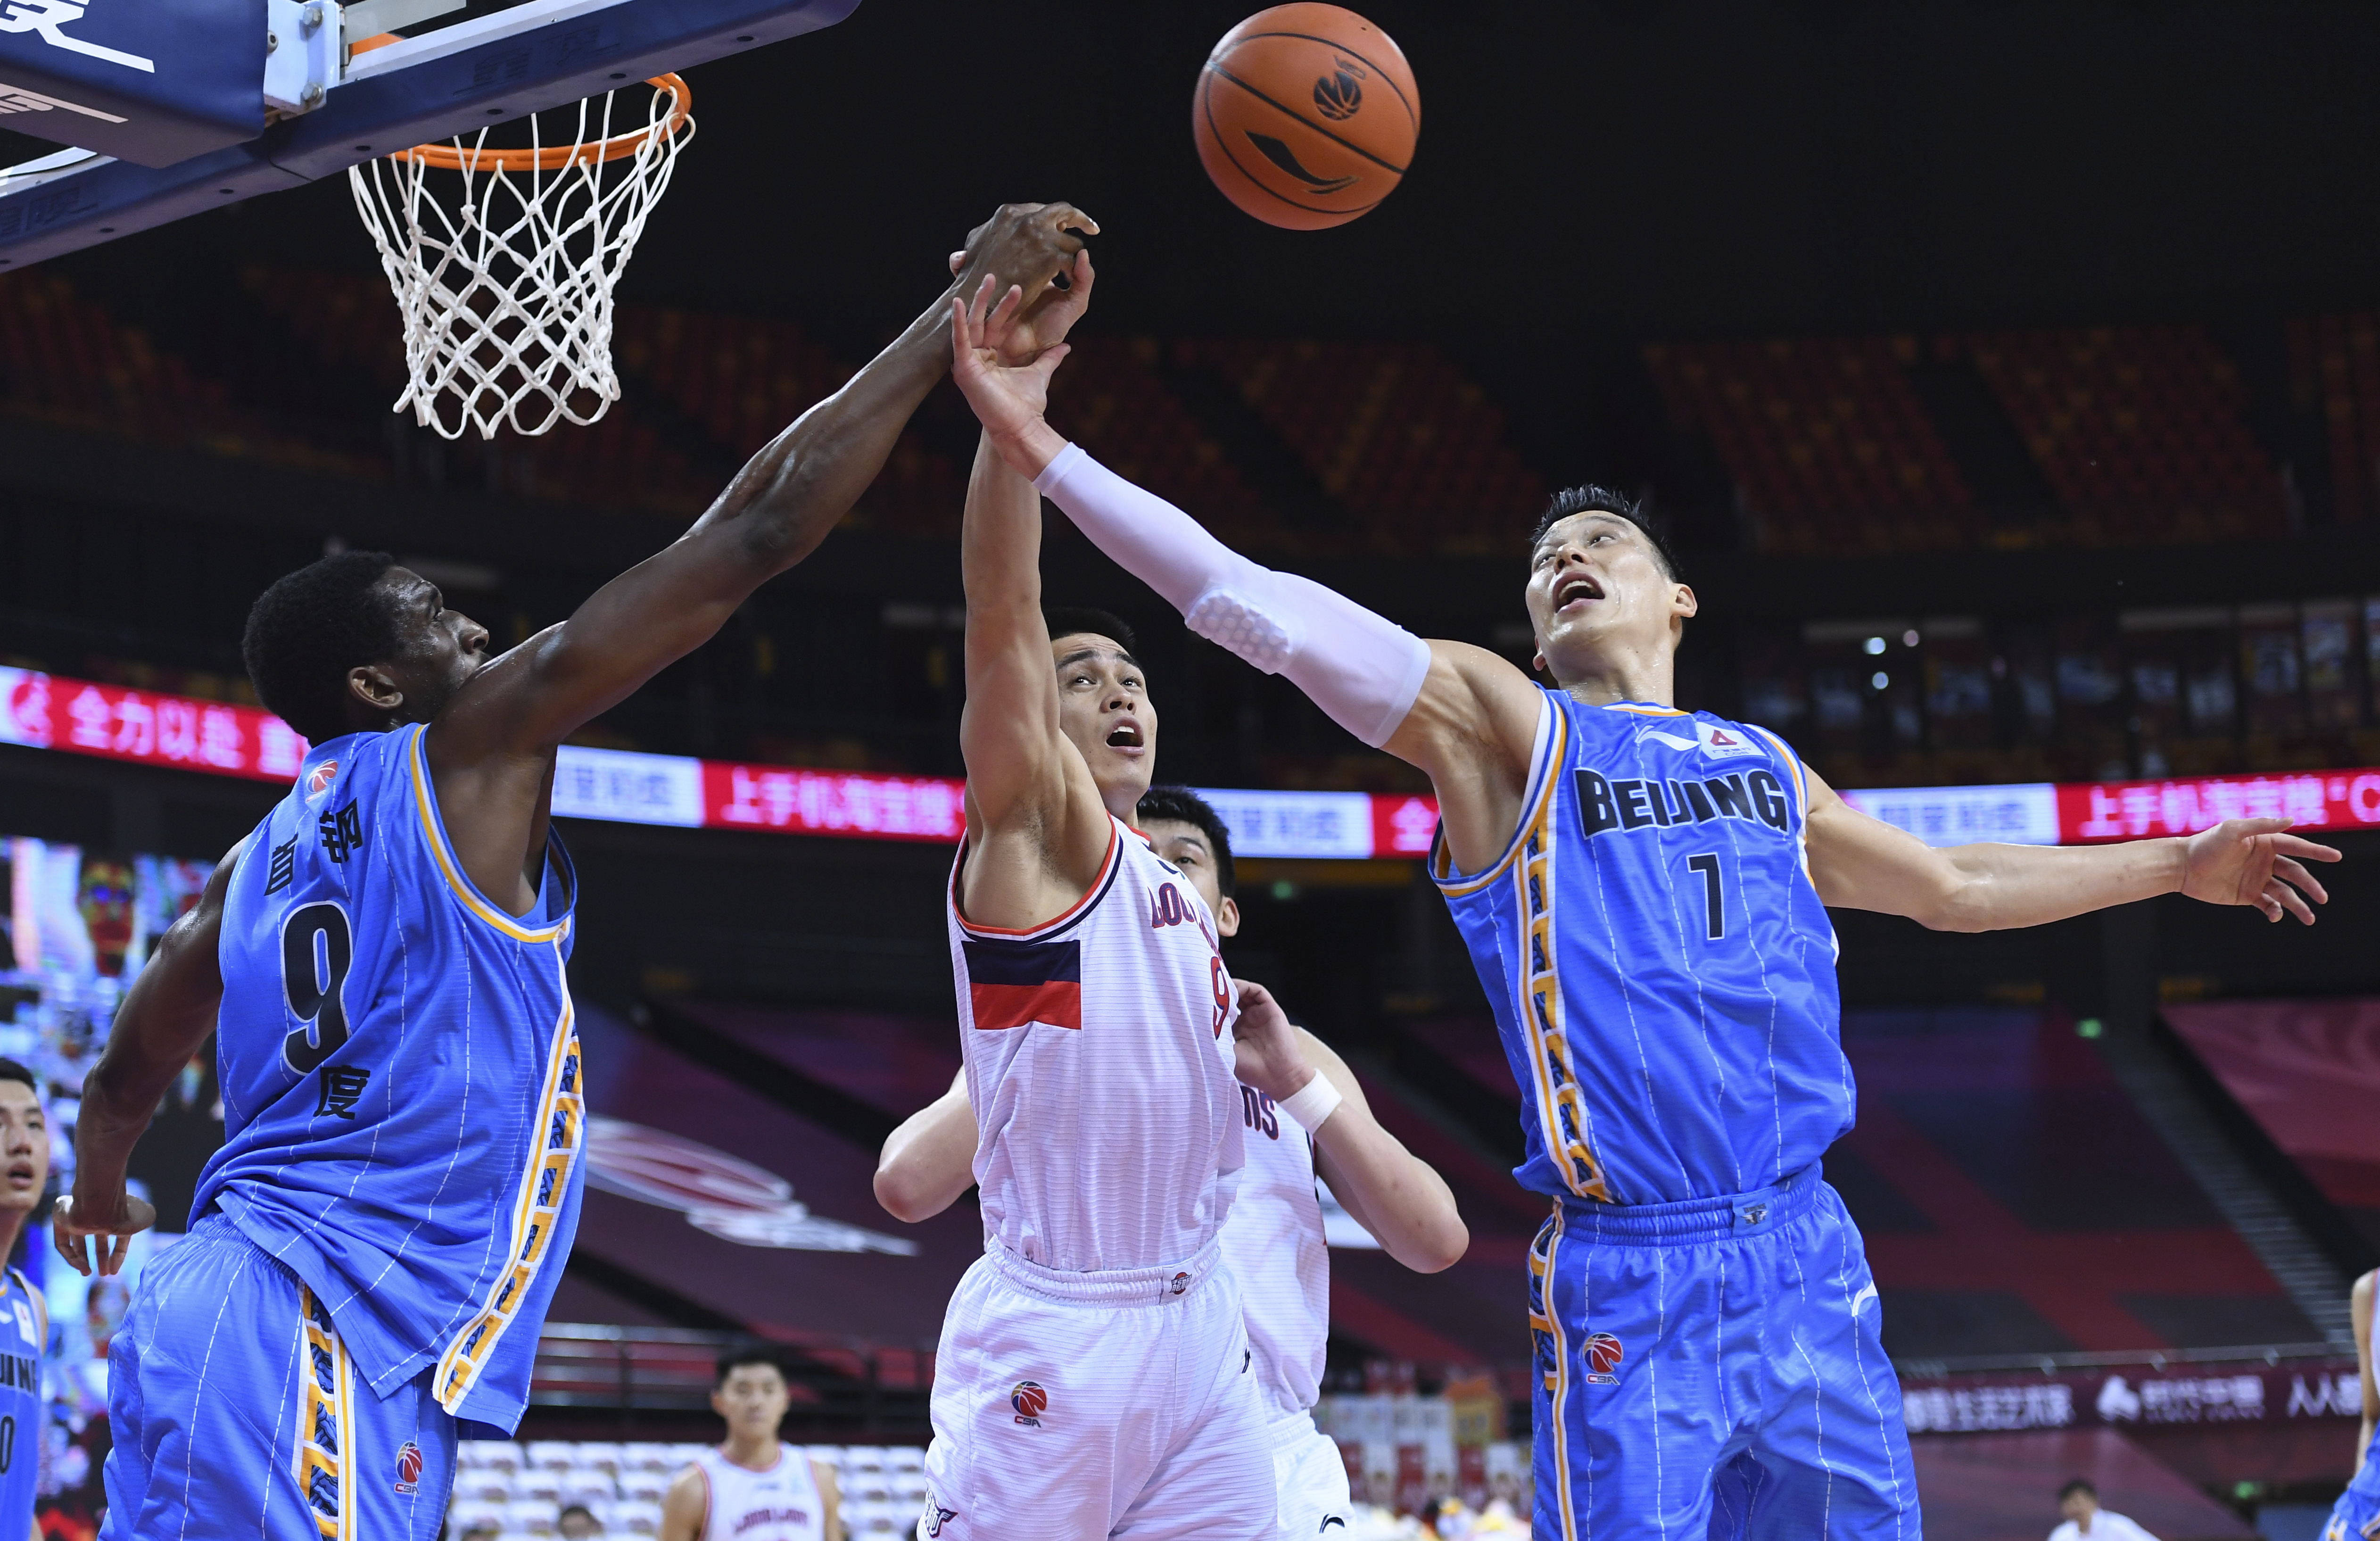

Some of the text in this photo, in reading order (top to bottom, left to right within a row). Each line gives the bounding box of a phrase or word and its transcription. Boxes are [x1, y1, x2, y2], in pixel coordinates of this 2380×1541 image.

[1573, 768, 1791, 840] BEIJING
[1686, 852, 1725, 940] 1
[281, 900, 353, 1077] 9
[1210, 956, 1230, 1041] 9
[1587, 1374, 1620, 1385] CBA
[1014, 1415, 1041, 1428] CBA
[395, 1483, 420, 1495] CBA
